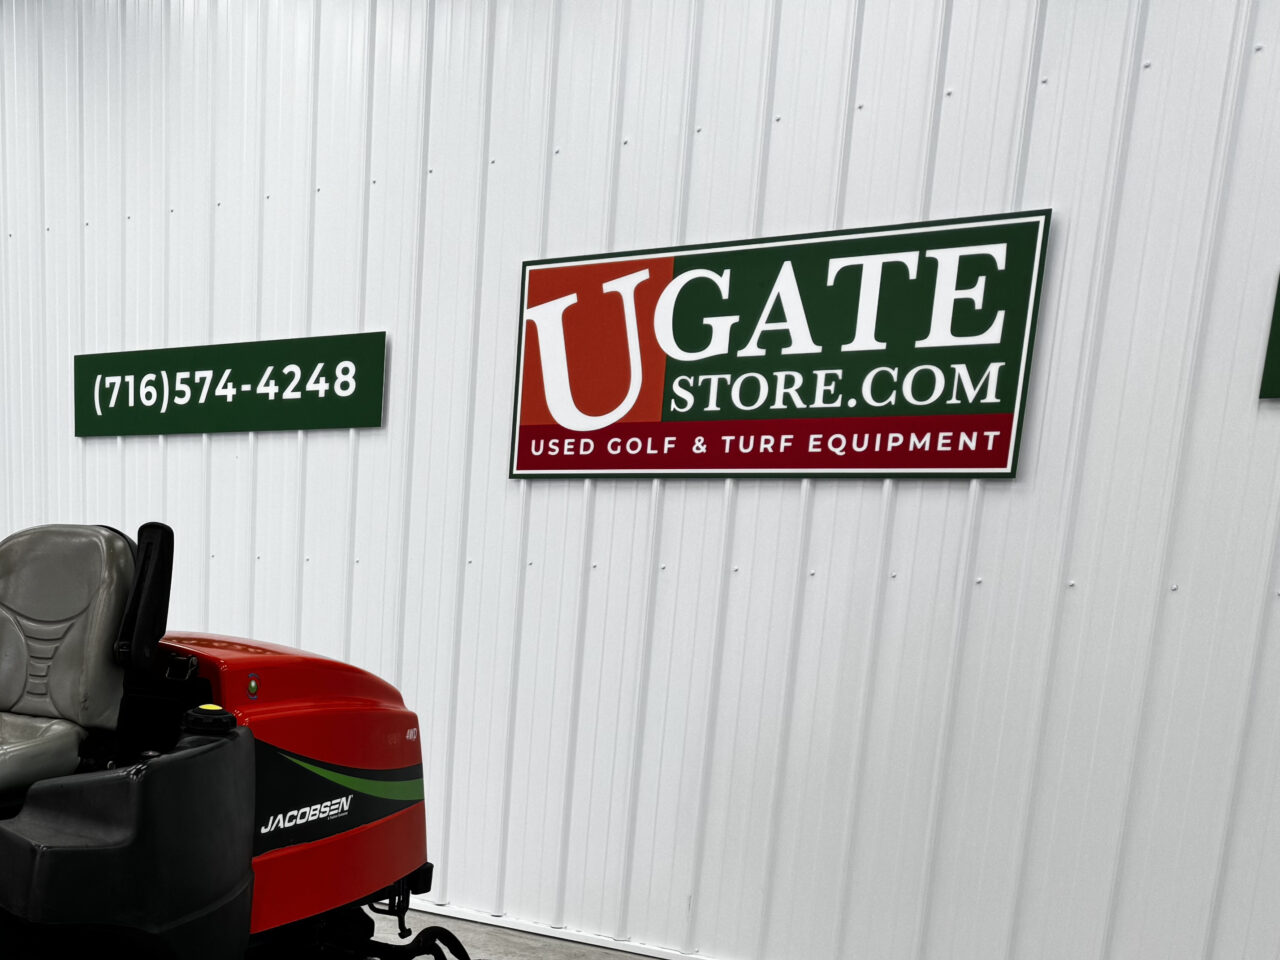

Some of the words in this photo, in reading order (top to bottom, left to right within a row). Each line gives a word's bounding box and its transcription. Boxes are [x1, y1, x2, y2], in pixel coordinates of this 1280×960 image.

[526, 242, 1008, 432] UGATE
[93, 360, 357, 416] (716)574-4248
[670, 361, 1006, 413] STORE.COM
[530, 437, 595, 457] USED
[607, 436, 678, 456] GOLF
[692, 436, 708, 454] &
[721, 434, 795, 454] TURF
[808, 430, 1001, 457] EQUIPMENT
[260, 795, 351, 834] JACOBSEN
